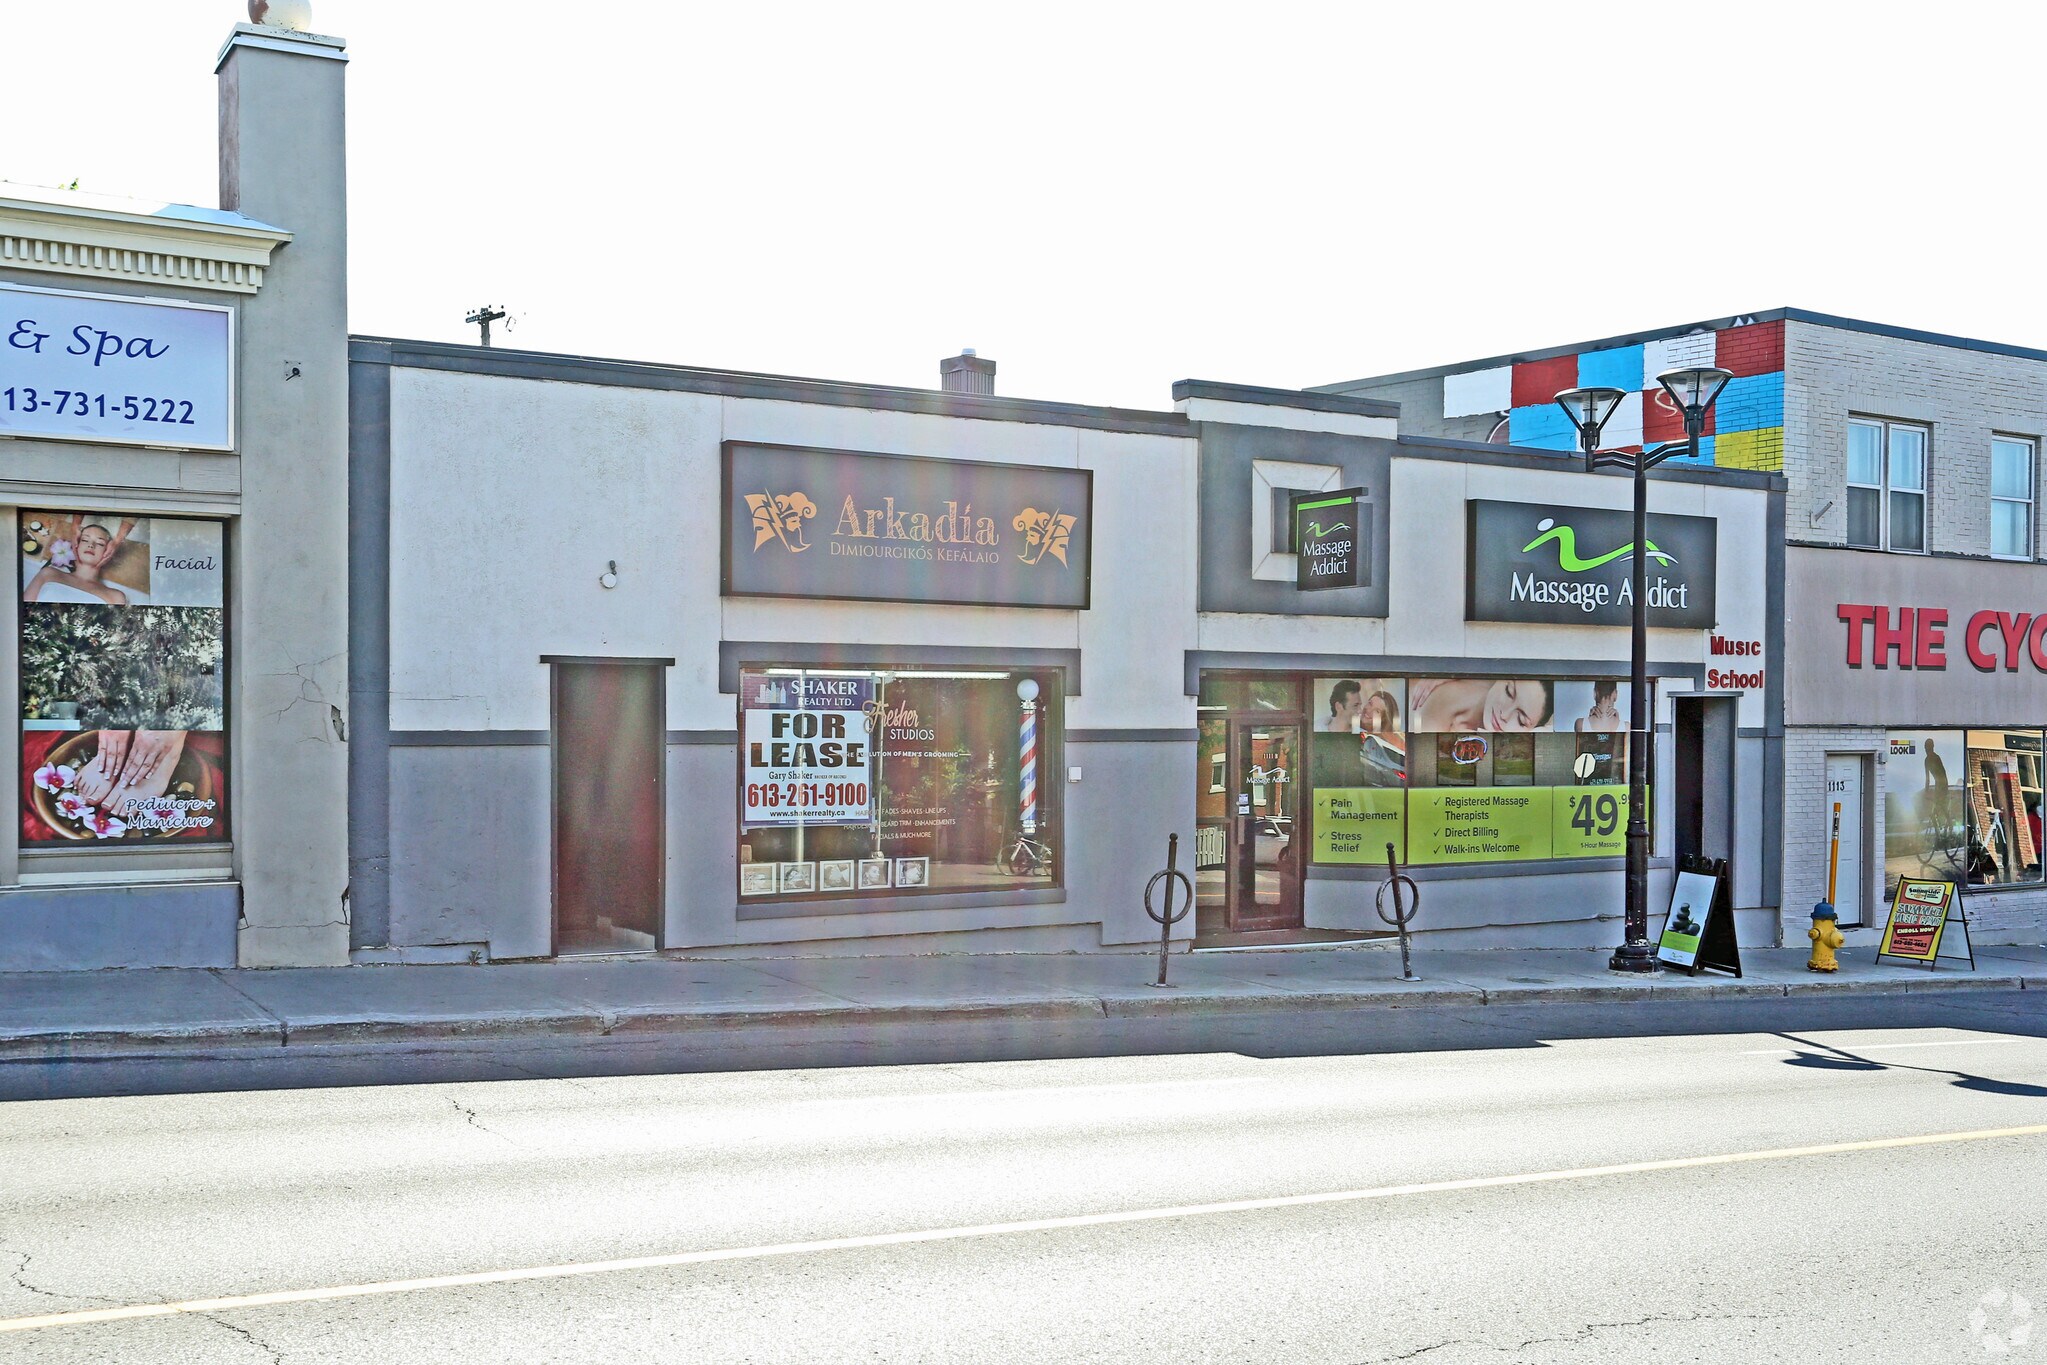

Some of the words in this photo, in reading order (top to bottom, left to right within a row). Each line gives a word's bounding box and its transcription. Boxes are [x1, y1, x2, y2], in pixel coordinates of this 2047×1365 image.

[8, 319, 50, 353] &
[66, 325, 170, 366] Spa
[1303, 540, 1352, 558] Massage
[155, 555, 217, 570] Facial
[1309, 557, 1348, 576] Addict
[1509, 571, 1609, 612] Massage
[1616, 576, 1688, 609] Adict
[1837, 603, 1948, 671] THE
[1710, 635, 1761, 656] Music
[1707, 668, 1764, 689] School
[791, 680, 858, 696] SHAKER
[798, 697, 833, 707] REALTY
[834, 697, 855, 707] LTD.
[862, 700, 920, 734] Fresher
[771, 713, 846, 739] FOR
[890, 728, 935, 741] STUDIOS
[750, 742, 865, 768] LEASE
[1890, 746, 1909, 755] LOOK
[768, 771, 787, 782] Gary
[1828, 780, 1845, 792] 1113
[747, 782, 867, 808] 613-261-9100
[1330, 798, 1353, 808] Pain
[1445, 796, 1490, 809] Registered
[1492, 795, 1529, 808] Massage
[881, 807, 900, 815] FADES
[1330, 811, 1398, 822] Management
[1445, 810, 1490, 822] Therapists
[128, 812, 212, 829] Manicure
[899, 819, 911, 827] TRIM
[1330, 831, 1362, 841] Stress
[1445, 827, 1471, 838] Direct
[1472, 827, 1499, 838] Billing
[1330, 843, 1360, 853] Relief
[1444, 844, 1480, 855] Walk-ins
[1481, 843, 1520, 853] Welcome
[1598, 840, 1621, 849] Massage
